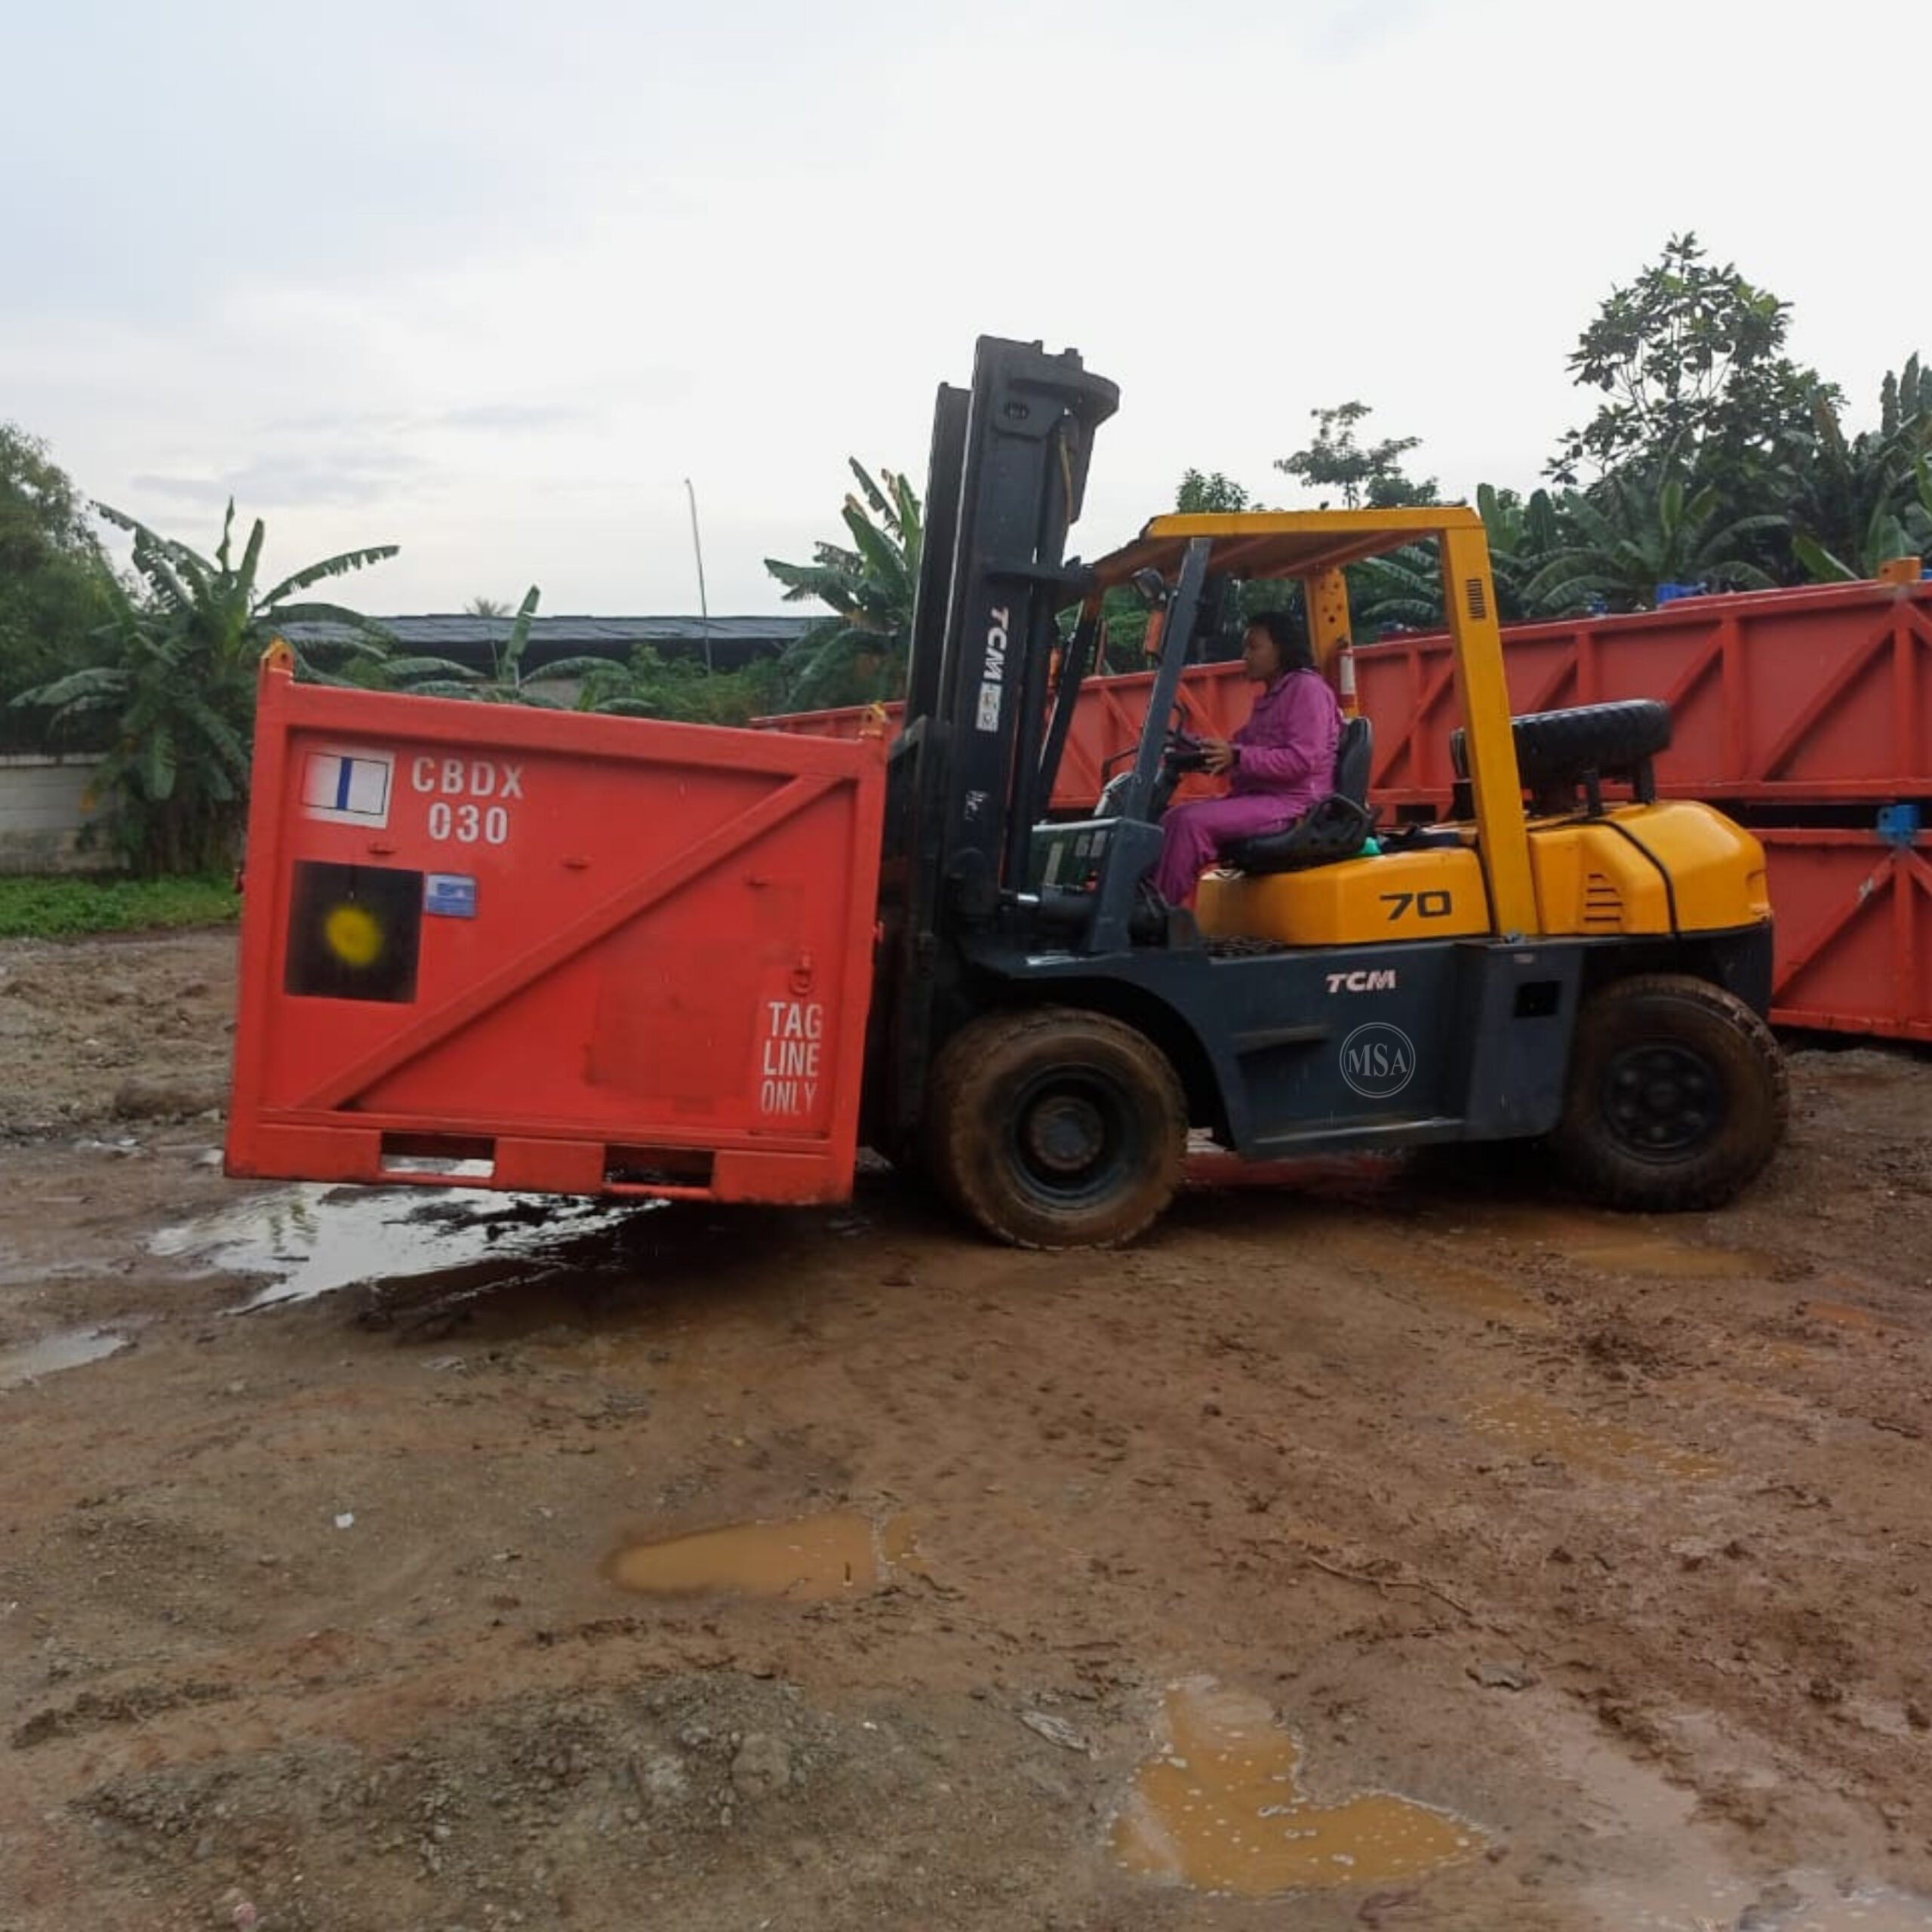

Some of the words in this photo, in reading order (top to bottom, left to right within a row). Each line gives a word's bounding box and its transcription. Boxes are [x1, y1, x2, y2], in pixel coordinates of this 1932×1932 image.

[983, 607, 1009, 680] TCM
[412, 755, 524, 798] CBDX
[429, 802, 508, 844] 030
[1380, 891, 1452, 921] 70
[1326, 969, 1396, 993] TCM
[767, 1001, 823, 1039] TAG
[763, 1038, 821, 1077] LINE
[761, 1079, 817, 1115] ONLY
